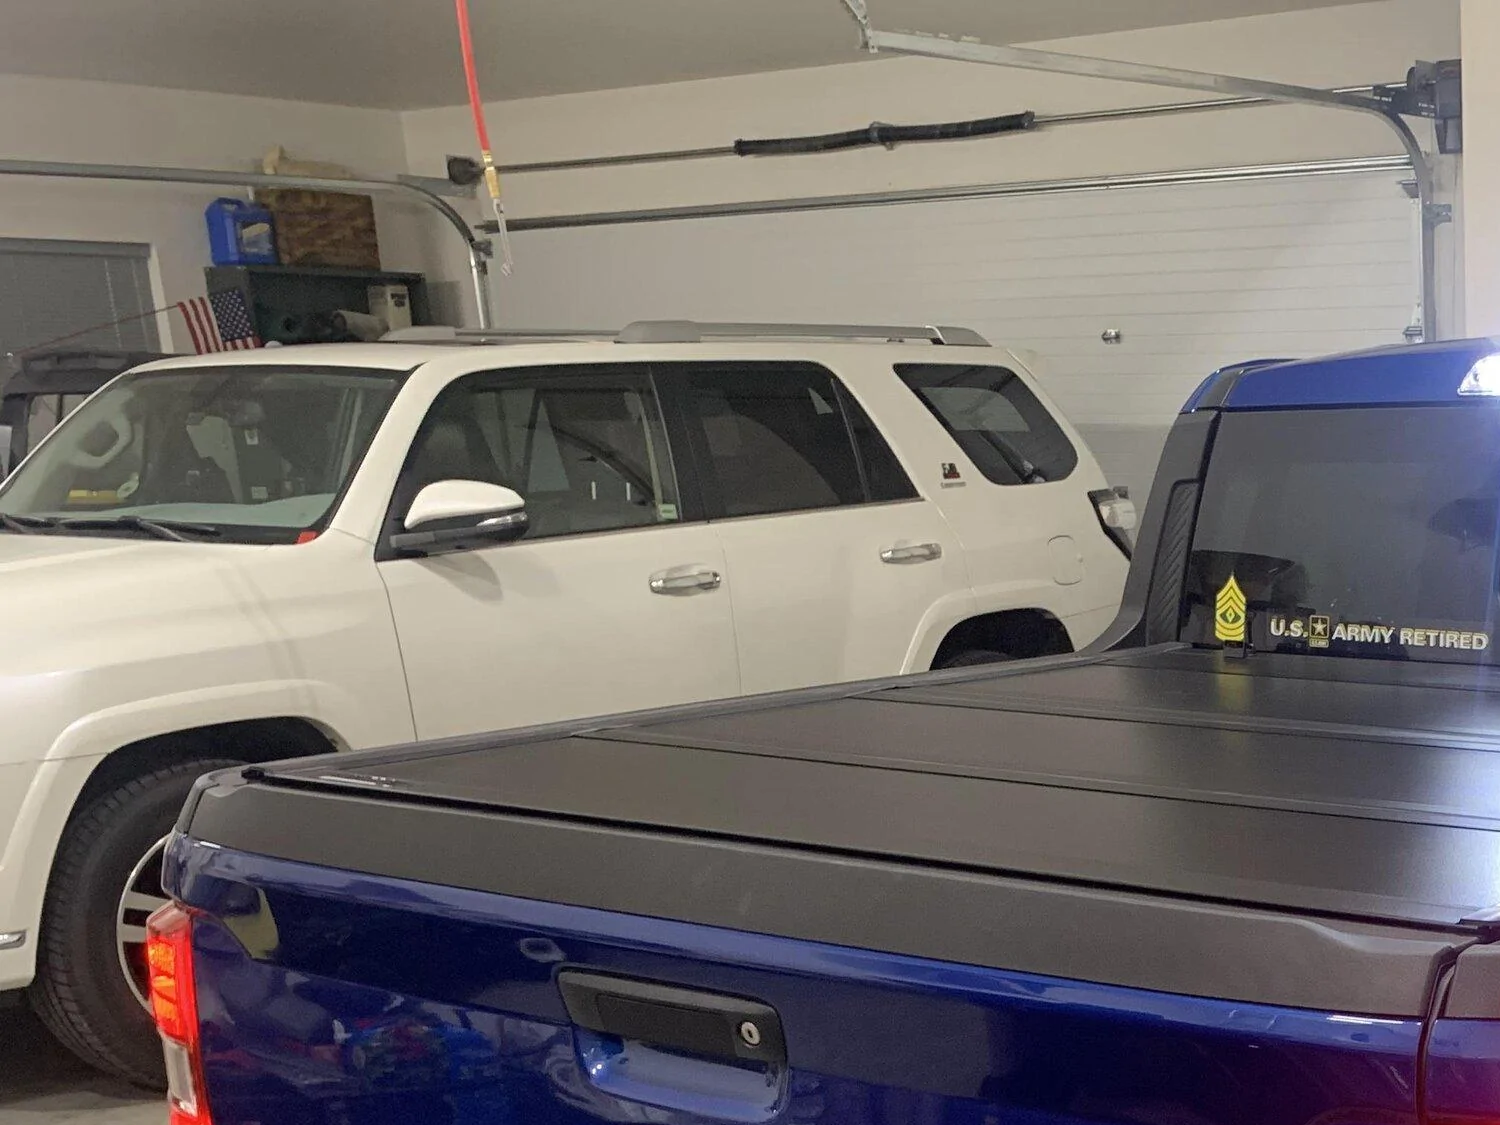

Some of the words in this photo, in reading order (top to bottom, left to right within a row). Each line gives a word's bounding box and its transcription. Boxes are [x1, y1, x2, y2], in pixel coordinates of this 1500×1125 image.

[1269, 617, 1308, 638] U.S.
[1331, 624, 1395, 644] ARMY
[1399, 627, 1489, 650] RETIRED
